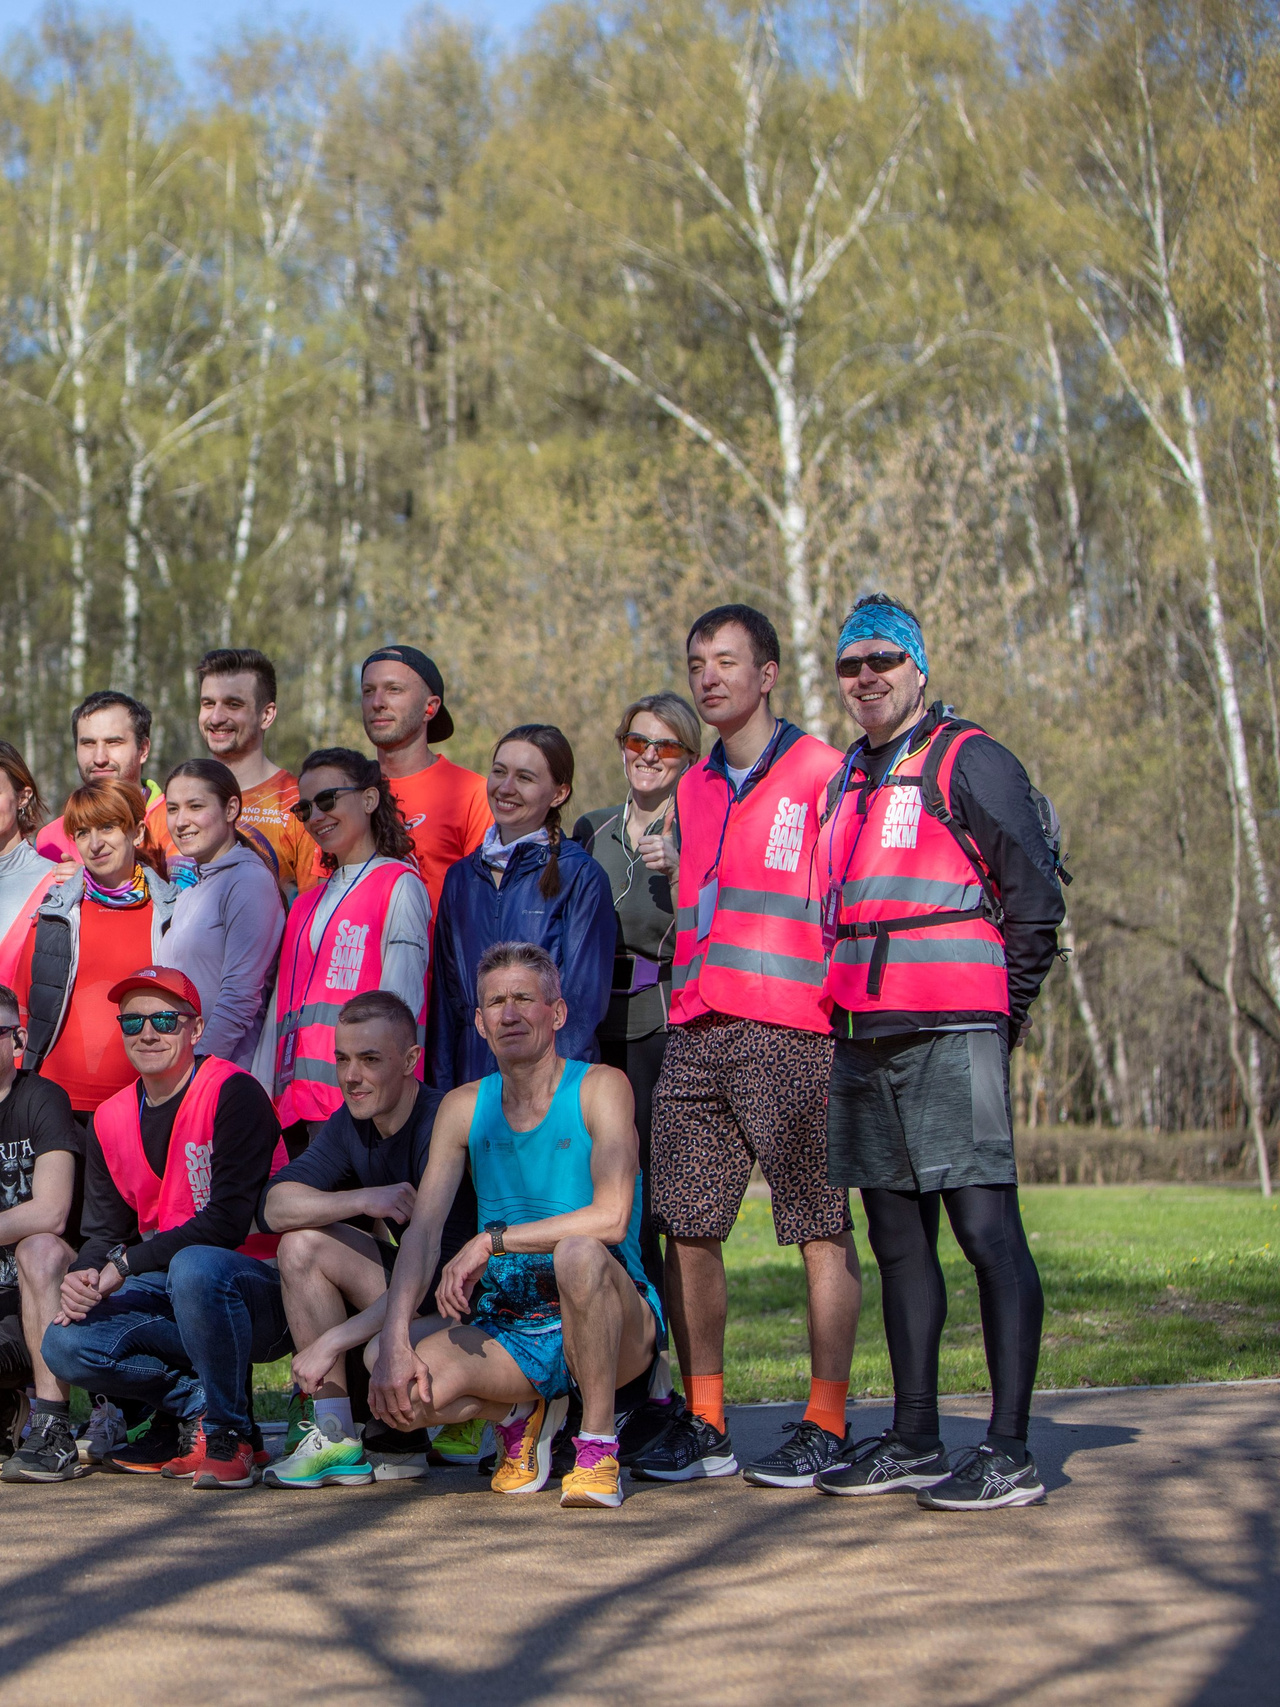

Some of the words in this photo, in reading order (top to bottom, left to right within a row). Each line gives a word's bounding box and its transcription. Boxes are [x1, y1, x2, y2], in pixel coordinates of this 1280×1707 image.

[241, 806, 261, 814] AND
[774, 796, 808, 829] Sat
[884, 803, 922, 826] 9AM
[768, 824, 804, 851] 9AM
[881, 824, 918, 849] 5KM
[764, 845, 800, 873] 5KM
[335, 919, 370, 949] Sat
[330, 945, 365, 971] 9AM
[326, 966, 360, 992] 5KM
[188, 1168, 213, 1192] 9A
